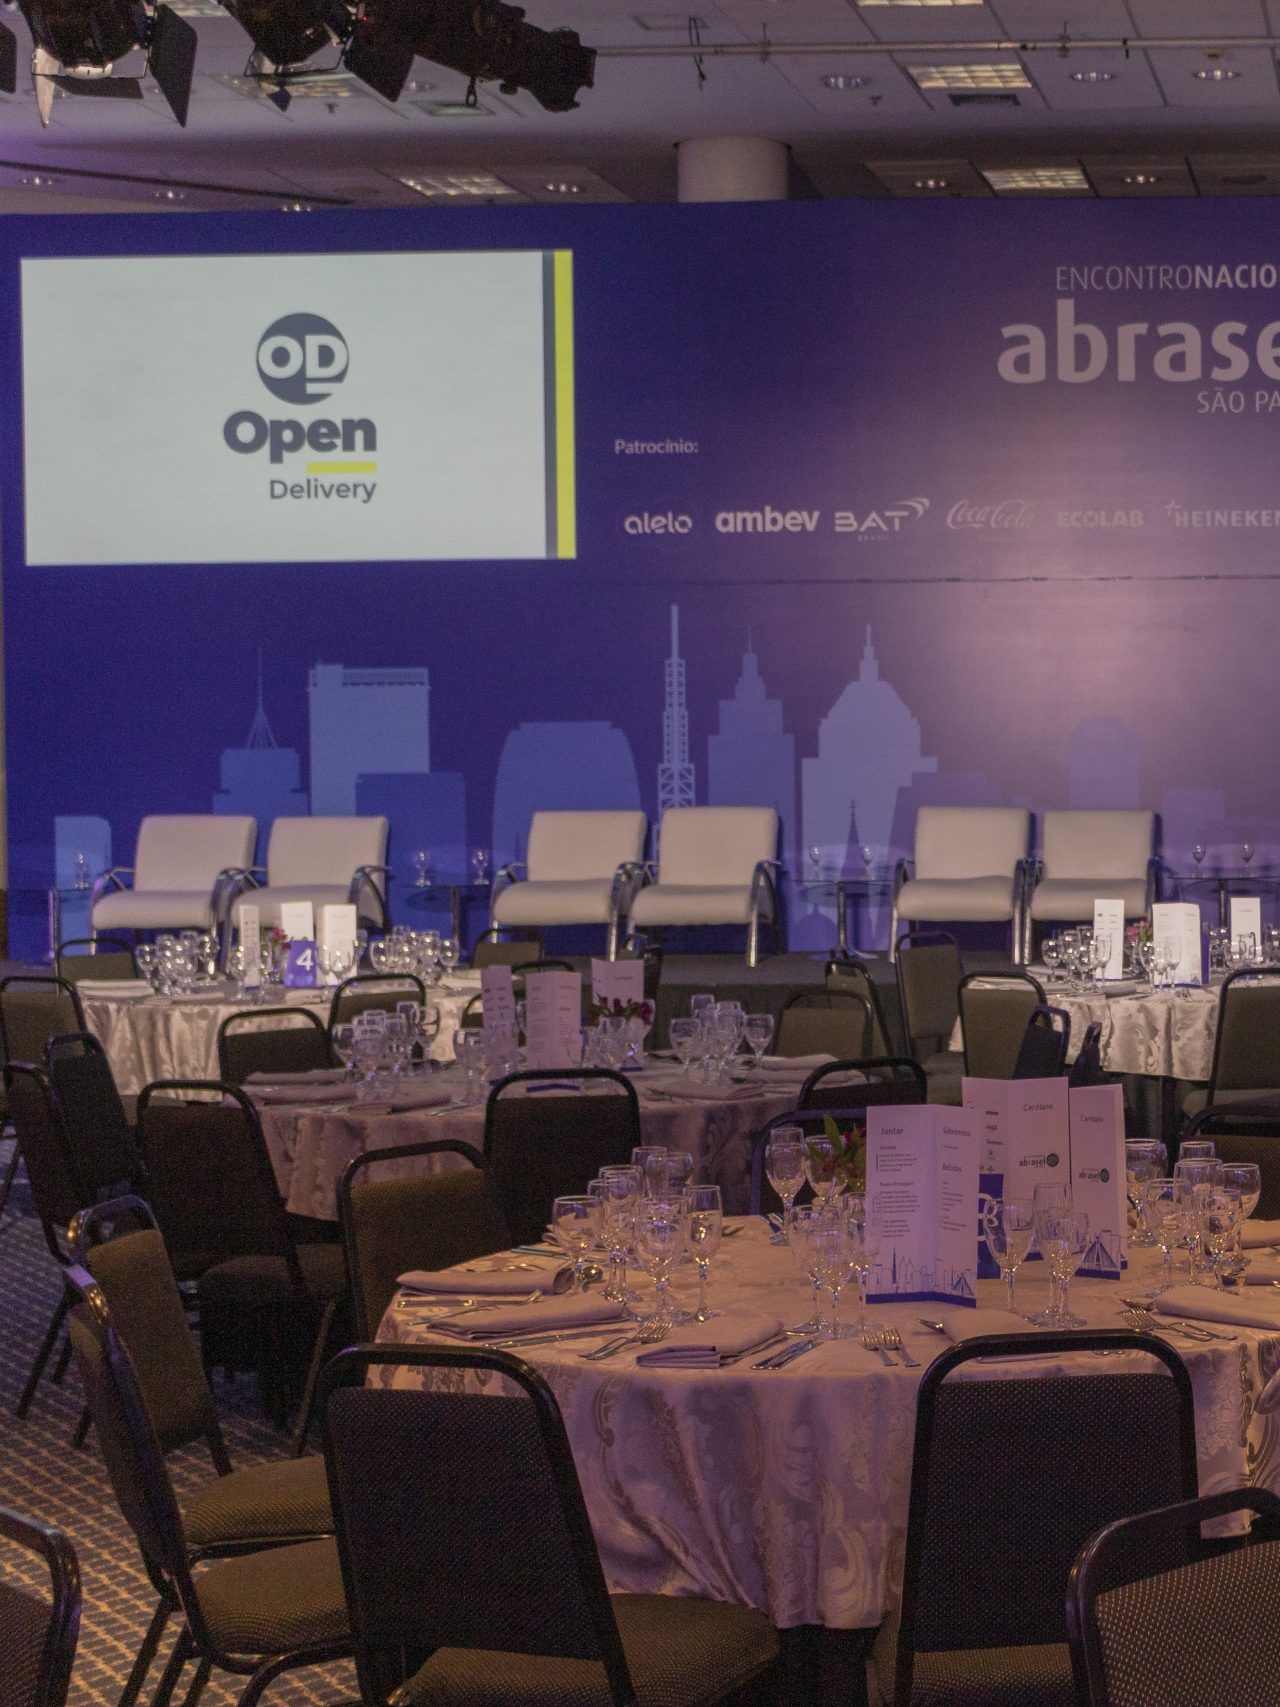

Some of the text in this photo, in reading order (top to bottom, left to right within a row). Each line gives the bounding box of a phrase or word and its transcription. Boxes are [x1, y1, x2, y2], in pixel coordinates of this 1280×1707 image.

[1197, 387, 1246, 413] SÃO
[222, 410, 377, 464] Open
[615, 437, 699, 455] Patrocínio:
[269, 478, 377, 504] Delivery
[624, 512, 692, 534] alelo
[714, 505, 820, 533] ambev
[834, 511, 909, 532] BAT
[1056, 509, 1145, 529] ECOLAB
[296, 948, 314, 971] 4
[880, 1127, 905, 1136] Jantar
